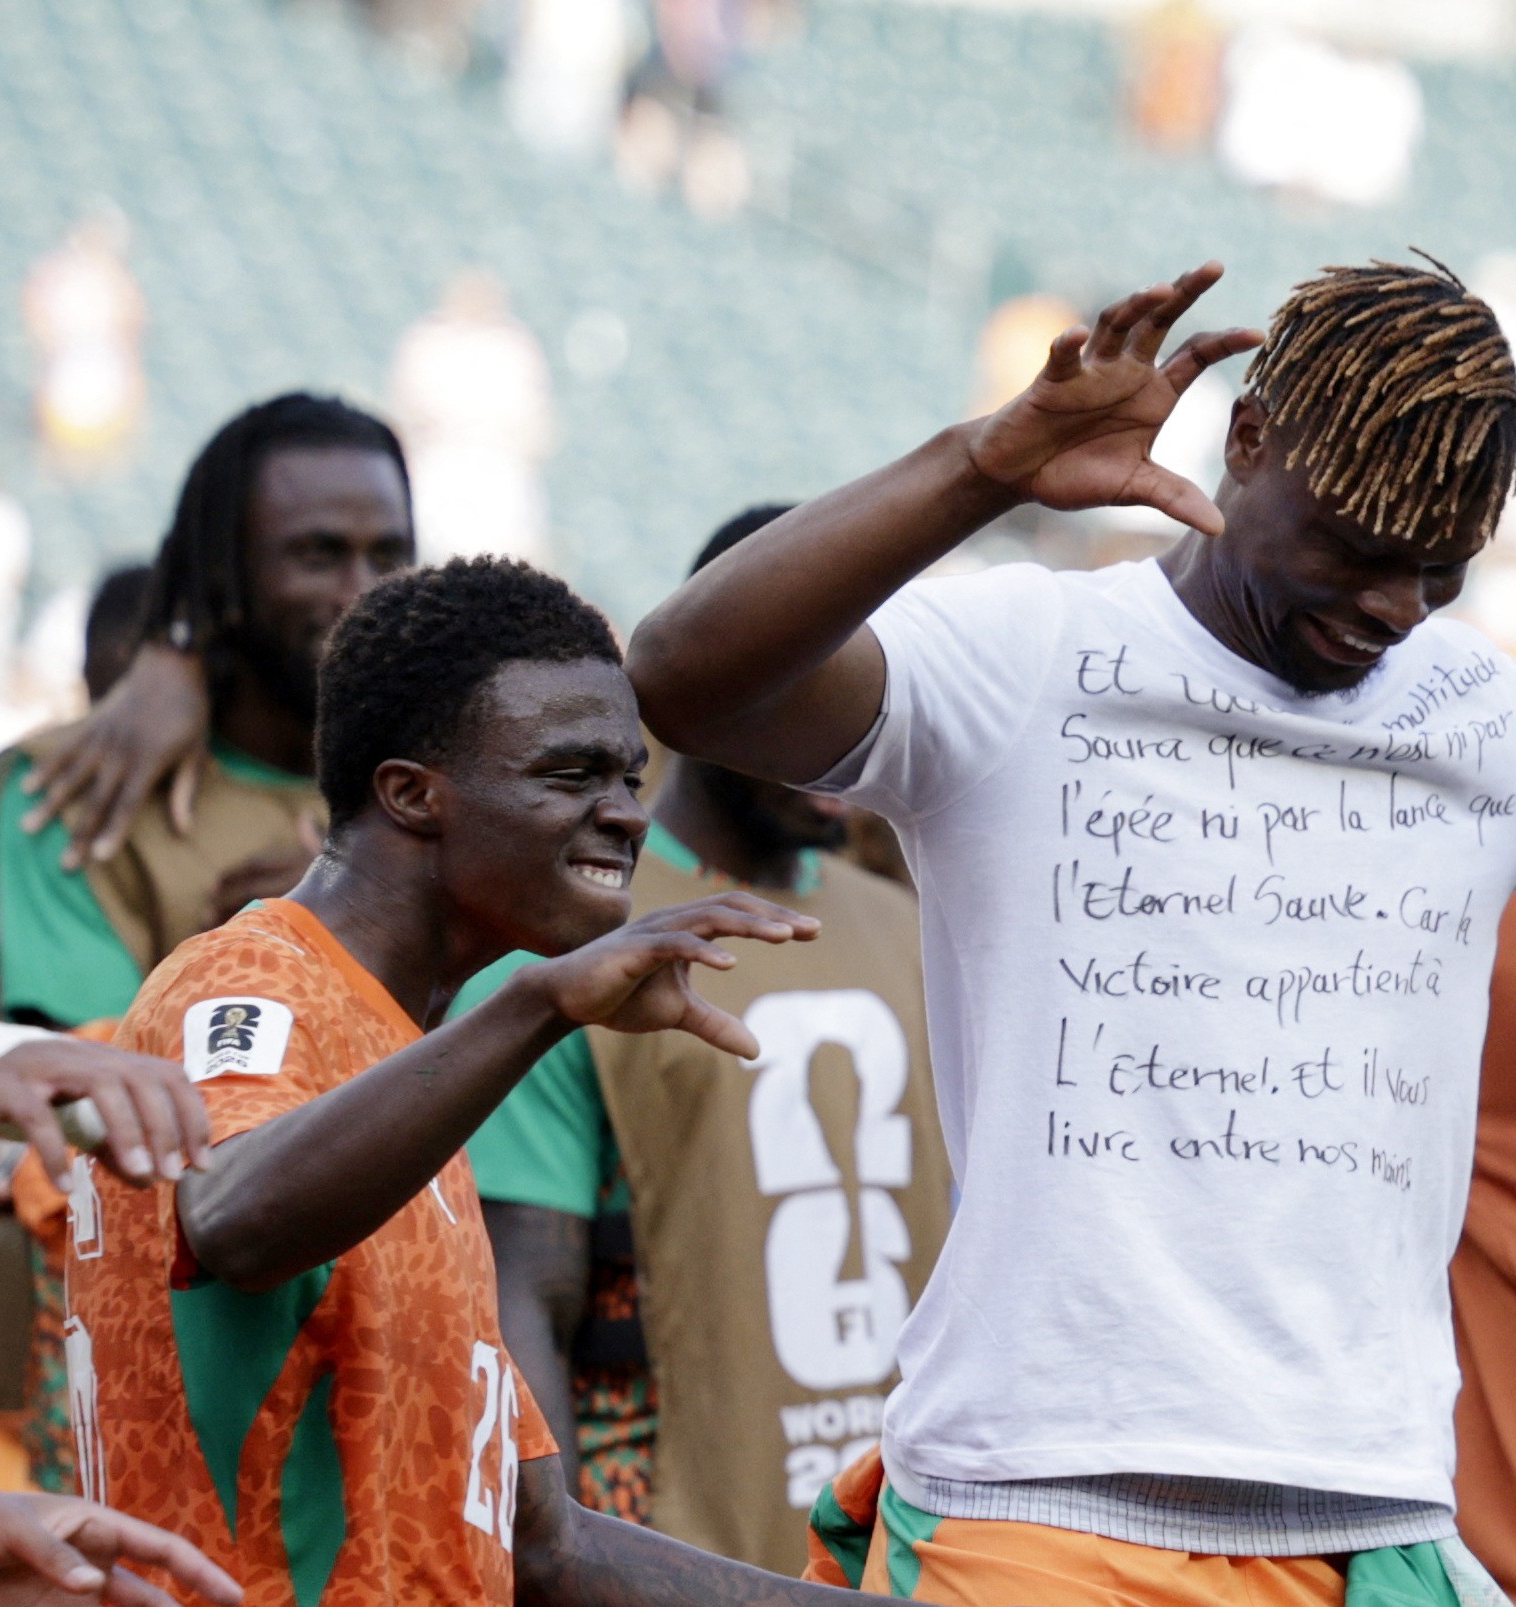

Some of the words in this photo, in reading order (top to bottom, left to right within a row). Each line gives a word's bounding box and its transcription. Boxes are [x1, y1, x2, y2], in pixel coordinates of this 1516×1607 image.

[1077, 645, 1143, 695] Et
[1209, 732, 1283, 790] que
[1468, 710, 1513, 774] par
[1201, 805, 1239, 841] ni
[1257, 802, 1322, 867] par
[1340, 780, 1370, 833] la
[1390, 771, 1455, 831] lance
[1400, 885, 1449, 934] Car
[1048, 1110, 1140, 1162] livre
[1298, 1136, 1359, 1171] nos
[463, 1339, 519, 1553] 26
